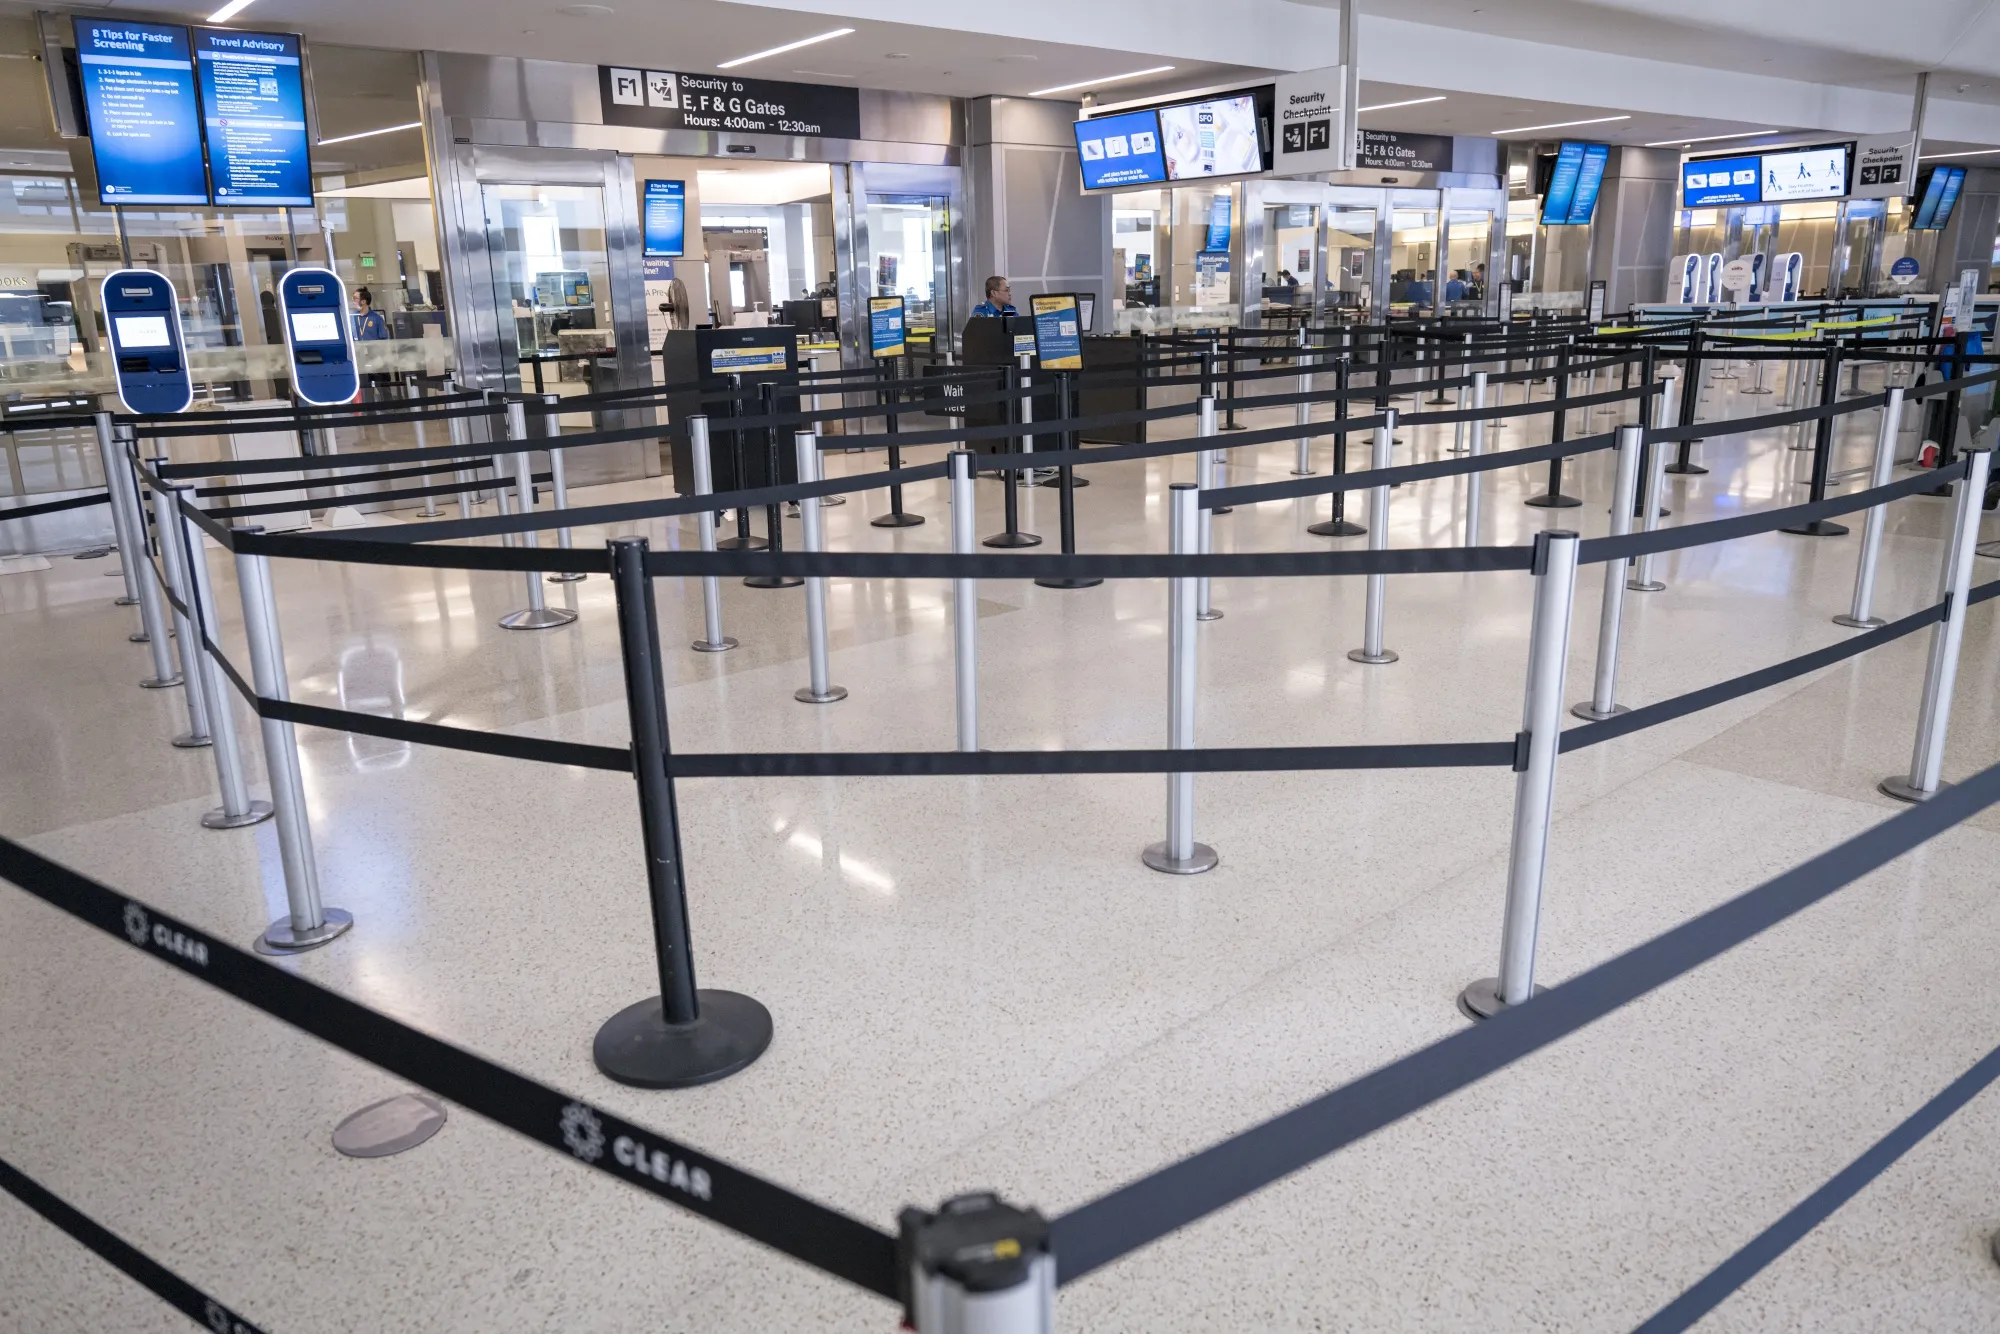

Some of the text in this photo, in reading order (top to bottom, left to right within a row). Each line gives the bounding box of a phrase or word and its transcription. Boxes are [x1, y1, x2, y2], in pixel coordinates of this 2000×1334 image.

[92, 29, 173, 43] 8 Tips for Faster
[94, 39, 144, 52] Screening
[210, 37, 284, 52] Travel Advisory
[618, 77, 637, 97] F1
[681, 76, 743, 92] Security to
[682, 94, 785, 116] E, F & G Gates
[1290, 92, 1325, 105] Security
[1200, 114, 1212, 123] SFO
[1284, 105, 1331, 119] Checkpoint
[684, 114, 720, 127] Hours:
[724, 116, 765, 130] 4:00am
[778, 120, 821, 134] 12:30am
[1310, 126, 1326, 143] F1
[1365, 132, 1388, 142] Security
[1365, 145, 1416, 157] E, F & G Gates
[1869, 146, 1899, 155] Security
[1365, 158, 1382, 166] Hours:
[1384, 159, 1405, 167] 4:00am
[1411, 160, 1433, 168] 12:30am
[1862, 155, 1903, 164] Checkpoint
[1883, 167, 1898, 179] F1
[944, 385, 963, 397] Wait
[153, 923, 209, 967] CLEAR
[613, 1136, 712, 1201] CLEAR
